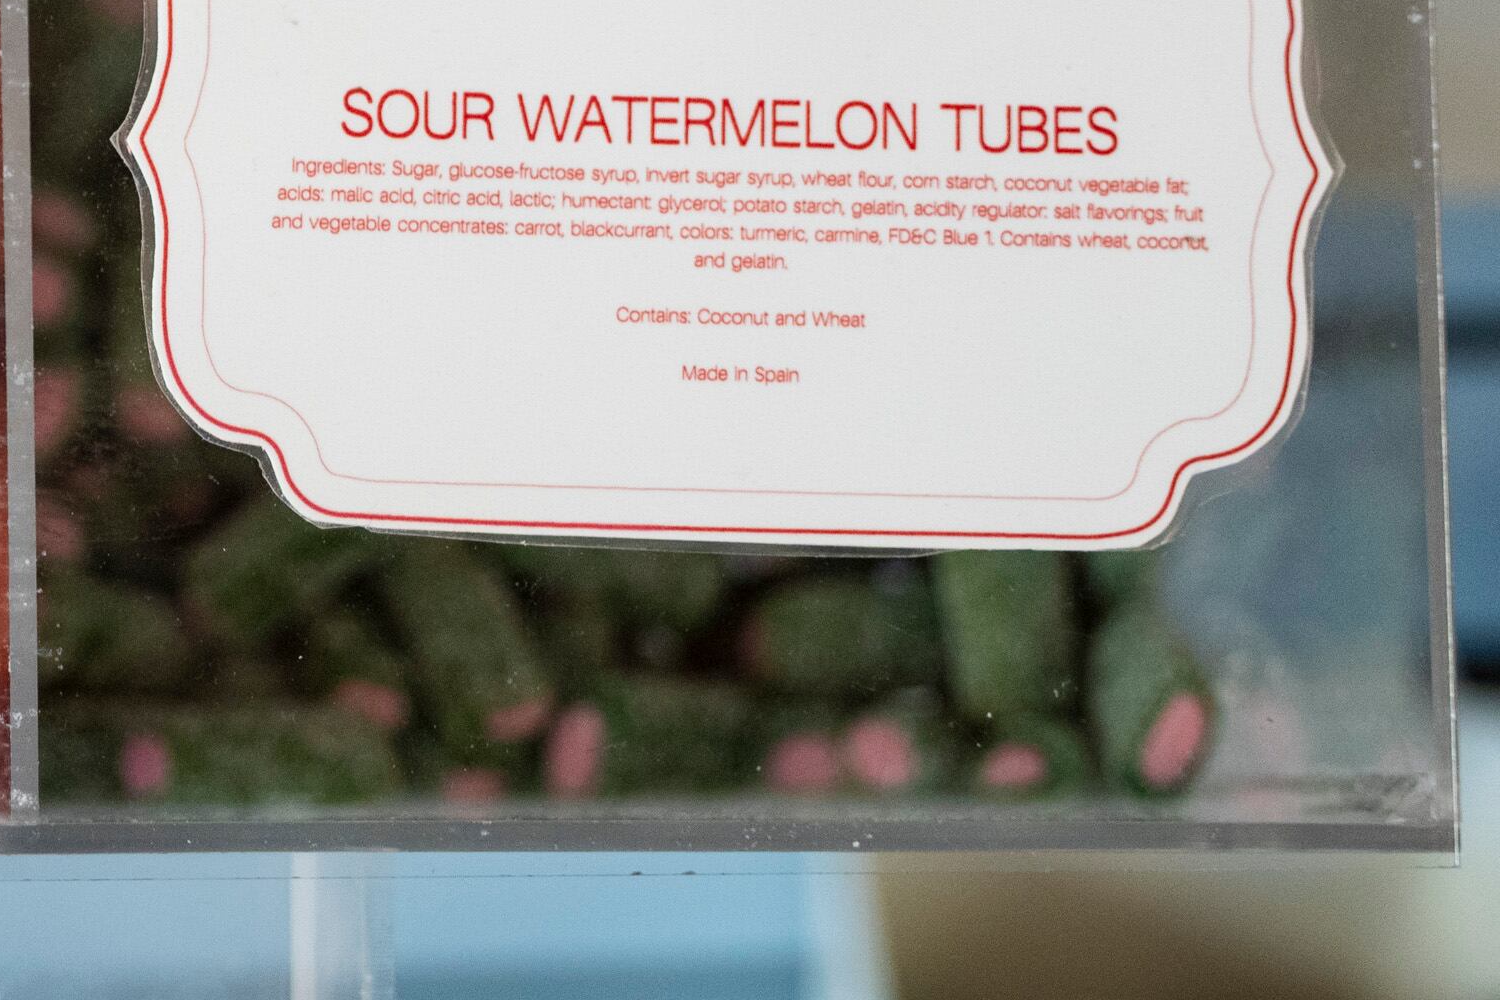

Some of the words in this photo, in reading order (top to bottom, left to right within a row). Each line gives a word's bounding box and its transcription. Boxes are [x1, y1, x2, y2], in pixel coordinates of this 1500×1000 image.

[340, 87, 496, 142] SOUR
[517, 92, 918, 153] WATERMELON
[939, 103, 1120, 157] TUBES
[292, 158, 386, 179] Ingredients:
[391, 159, 443, 182] Sugar,
[447, 161, 587, 184] glucose-fructose
[591, 168, 640, 186] syrup,
[645, 168, 692, 185] invert
[695, 170, 742, 190] sugar
[747, 170, 797, 190] syrup,
[801, 171, 853, 189] wheat
[857, 169, 898, 191] flour,
[901, 174, 941, 190] corn
[945, 174, 999, 193] starch,
[1003, 176, 1074, 194] coconut
[1076, 178, 1162, 198] vegetable
[276, 185, 326, 203] acids:
[330, 186, 374, 204] malic
[378, 187, 418, 207] acid,
[422, 190, 462, 207] citric
[465, 190, 505, 210] acid,
[509, 191, 556, 211] lactic;
[731, 199, 789, 217] potato
[792, 199, 846, 217] starch,
[851, 200, 910, 221] gelatin,
[913, 200, 968, 222] acidity
[1053, 204, 1082, 221] salt
[1173, 204, 1205, 224] fruit
[271, 215, 306, 231] and
[309, 215, 393, 236] vegetable
[396, 217, 509, 237] concentrates:
[514, 221, 565, 238] carrot,
[569, 218, 675, 242] blackcurrant,
[679, 225, 734, 242] colors:
[739, 225, 809, 245] turmeric,
[813, 228, 884, 246] carmine,
[887, 226, 937, 247] FD&C
[941, 227, 981, 248] Blue
[999, 229, 1074, 249] Contains
[1076, 232, 1133, 252] wheat,
[1135, 233, 1211, 254] coconut,
[693, 252, 727, 270] and
[730, 254, 789, 274] gelatin.
[615, 305, 692, 326] Contains:
[696, 307, 771, 328] Coconut
[774, 312, 808, 329] and
[811, 311, 867, 329] Wheat
[681, 363, 730, 383] Made
[734, 366, 749, 383] in
[755, 365, 801, 385] Spain
